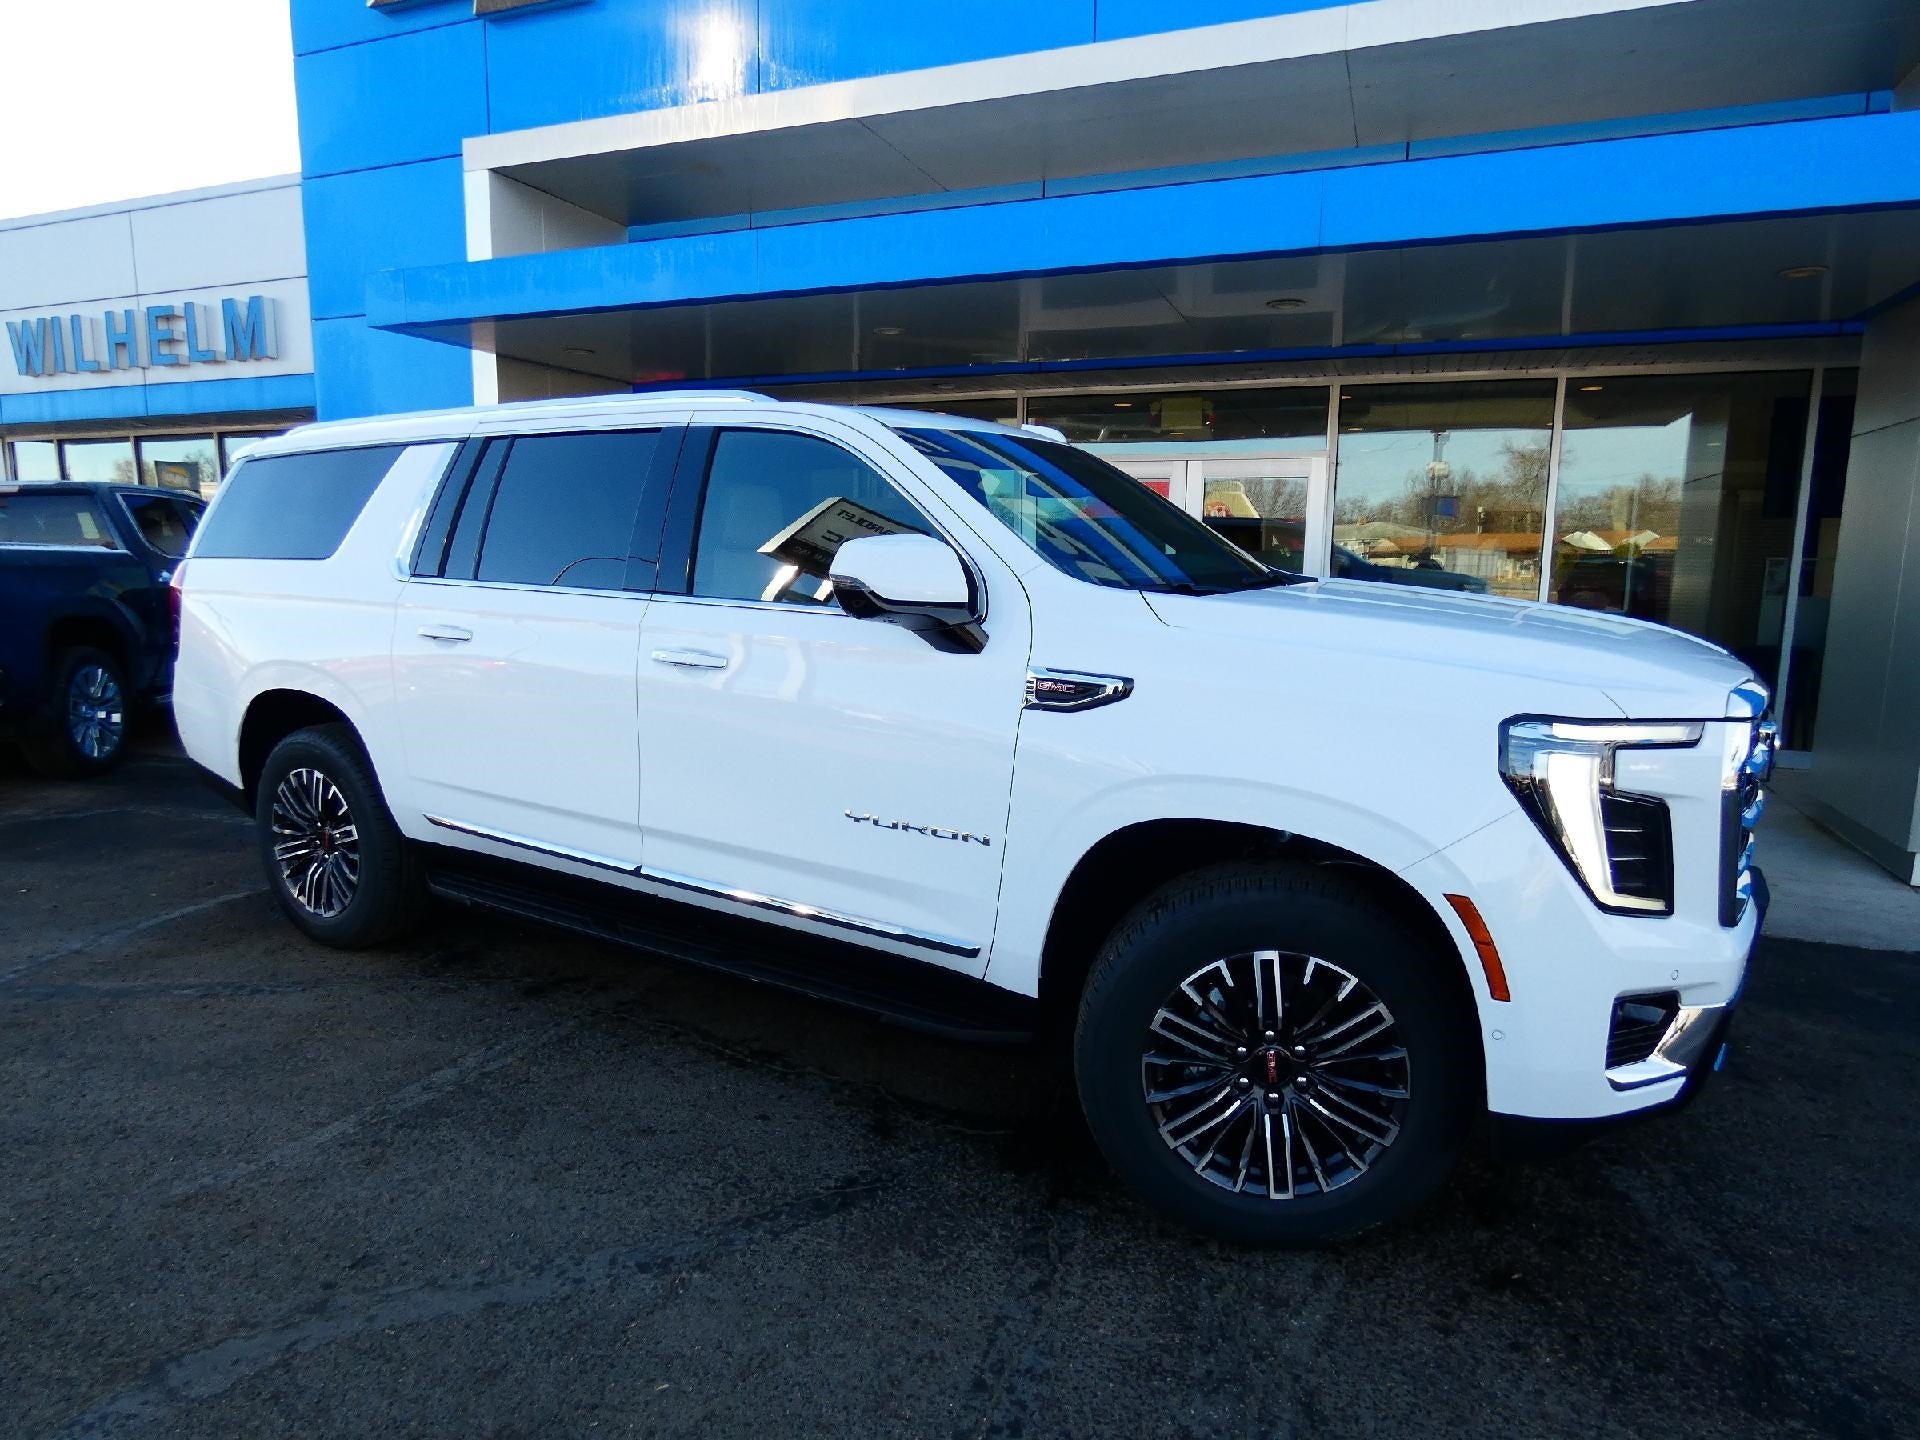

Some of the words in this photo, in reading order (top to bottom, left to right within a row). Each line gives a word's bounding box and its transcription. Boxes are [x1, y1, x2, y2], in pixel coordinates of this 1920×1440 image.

[6, 296, 272, 376] WILHELM
[1036, 680, 1076, 694] GMC
[843, 808, 990, 846] YUKON
